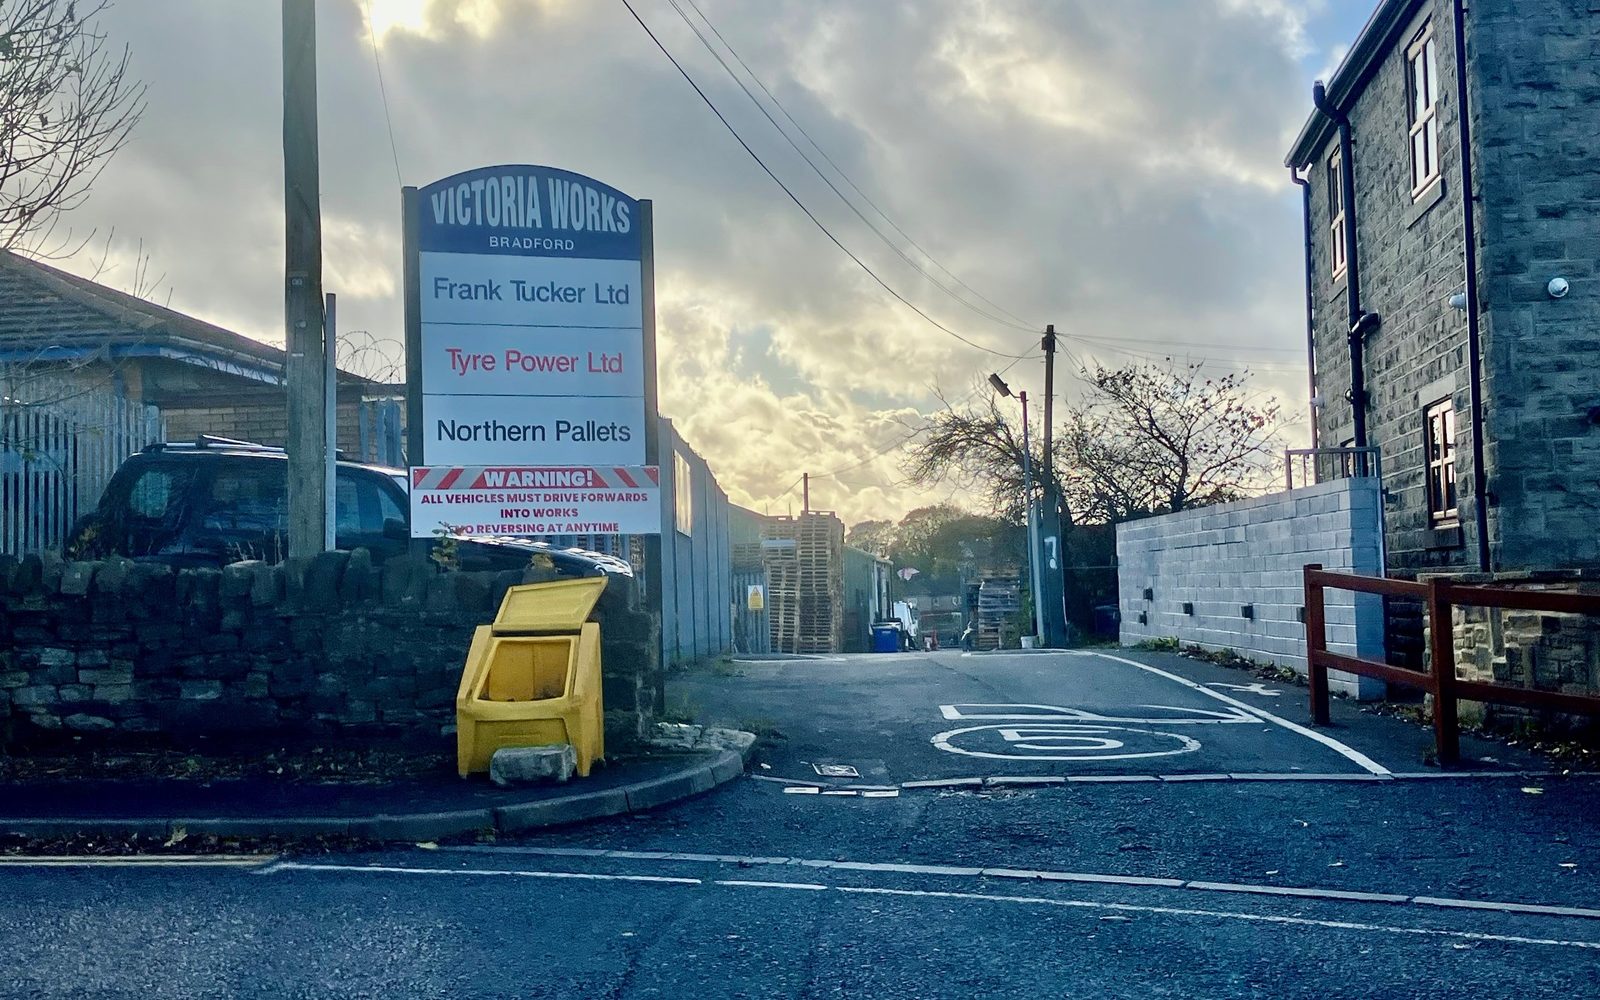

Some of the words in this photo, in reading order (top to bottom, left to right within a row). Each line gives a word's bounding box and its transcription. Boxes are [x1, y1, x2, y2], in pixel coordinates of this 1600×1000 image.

[432, 175, 542, 228] VICTORIA
[547, 177, 631, 233] WORKS
[489, 236, 574, 250] BRADFORD
[434, 276, 503, 300] Frank
[510, 280, 586, 303] Tucker
[595, 283, 629, 305] Ltd
[446, 349, 496, 376] Tyre
[505, 350, 579, 373] Power
[588, 352, 623, 373] Ltd
[437, 420, 546, 441] Northern
[556, 420, 631, 442] Pallets
[483, 471, 593, 487] WARNING!
[421, 494, 444, 504] ALL
[445, 493, 505, 504] VEHICLES
[506, 493, 542, 503] MUST
[543, 493, 579, 502] DRIVE
[581, 493, 648, 502] FORWARDS
[500, 509, 531, 519] INTO
[533, 508, 579, 518] WORKS
[476, 524, 545, 534] REVERSING
[547, 524, 563, 533] AT
[565, 522, 619, 533] ANYTIME
[998, 729, 1124, 751] 5
